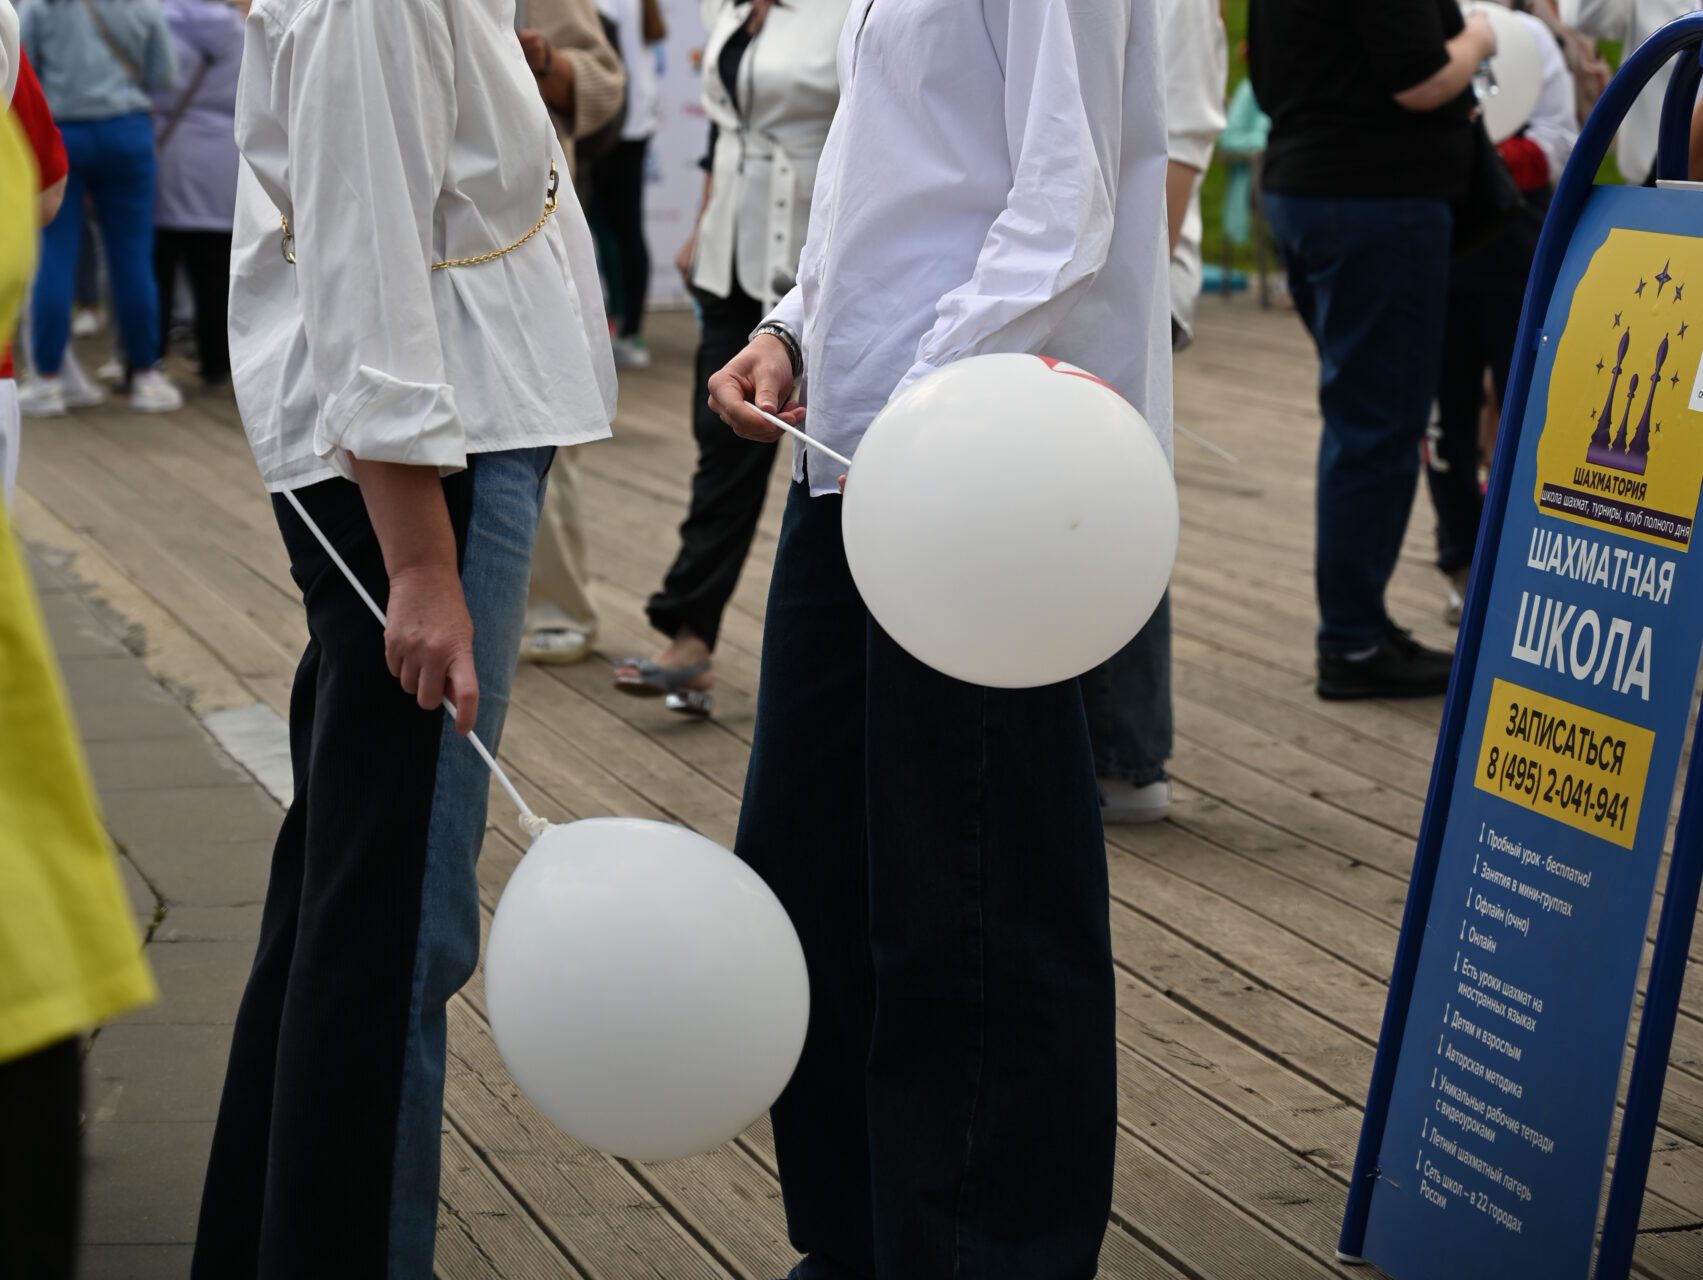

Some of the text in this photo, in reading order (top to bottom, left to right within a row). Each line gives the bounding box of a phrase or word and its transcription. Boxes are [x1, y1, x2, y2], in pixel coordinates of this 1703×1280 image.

[1573, 467, 1647, 501] ШАХМАТОРИЯ
[1541, 489, 1691, 538] школа шахмат, турниры, клуб полного дня
[1527, 528, 1677, 605] ШАХМАТНАЯ
[1511, 591, 1653, 702] ШКОЛА
[1505, 702, 1627, 776] ЗАПИСАТЬСЯ
[1486, 746, 1630, 831] 8 (495) 2-041-941
[1486, 829, 1522, 858] Пробный
[1521, 848, 1541, 867] урок
[1545, 855, 1592, 888] бесплатно!
[1474, 894, 1530, 937] Офлайн (очно)
[1480, 862, 1573, 917] Занятия в мини-группах
[1468, 926, 1497, 954] Онлайн
[1457, 982, 1537, 1032] иностранных языках
[1461, 958, 1543, 1013] Есть уроки шахмат на
[1451, 1010, 1522, 1061] Детям и взрослым
[1444, 1042, 1523, 1099] Авторская методика
[1435, 1099, 1496, 1143] с видеоуроками
[1439, 1074, 1554, 1153] Уникальные рабочие тетради
[1428, 1127, 1532, 1202] Летний шахматный лагерь
[1420, 1179, 1447, 1209] России
[1424, 1160, 1441, 1184] Сеть
[1441, 1174, 1463, 1197] школ
[1469, 1191, 1476, 1205] в
[1476, 1192, 1489, 1213] 22
[1488, 1202, 1523, 1233] городах
